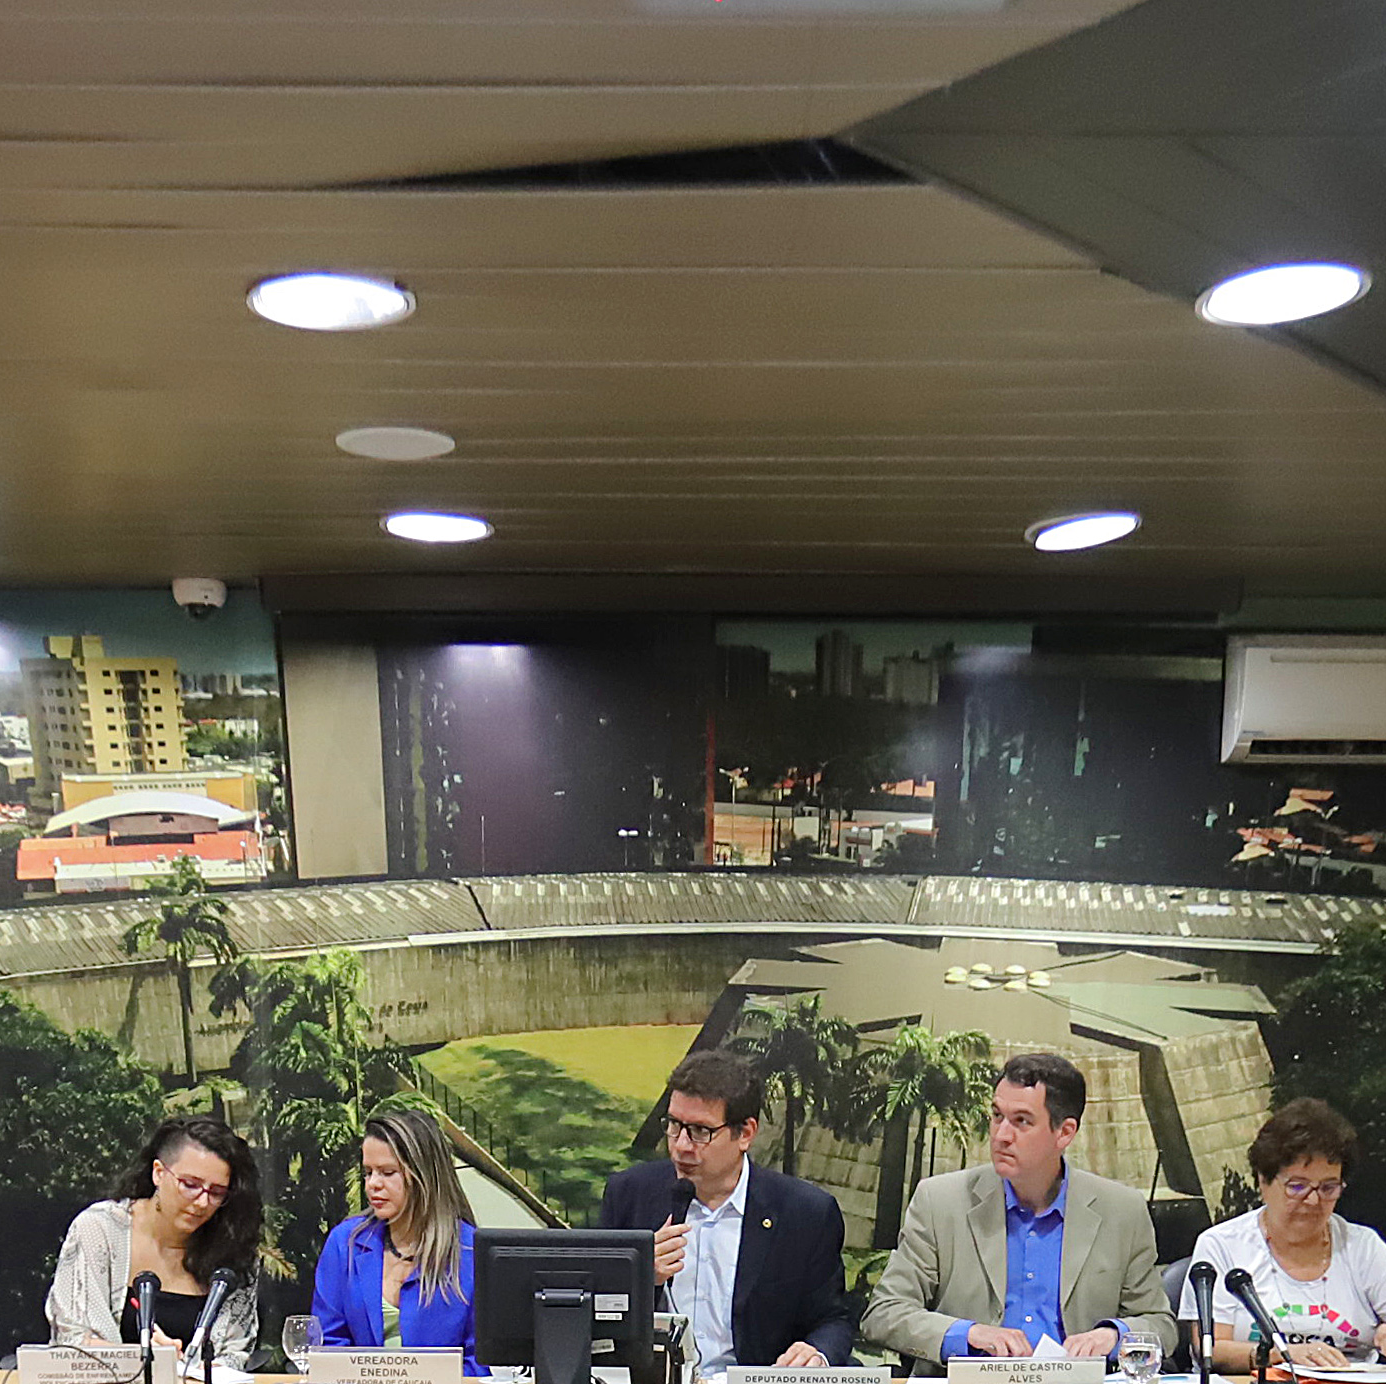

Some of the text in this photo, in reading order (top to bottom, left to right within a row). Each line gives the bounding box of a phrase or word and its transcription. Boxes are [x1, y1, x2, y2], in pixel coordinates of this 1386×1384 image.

[101, 1350, 138, 1360] MACIEL
[350, 1356, 418, 1365] VEREADORA
[71, 1362, 119, 1371] BEZERRA
[980, 1362, 1073, 1372] ARIEL DE CASTRO
[361, 1368, 408, 1377] ENEDINA
[745, 1375, 881, 1384] DEPUTADO RENATO ROSENO
[1008, 1374, 1043, 1383] ALVES
